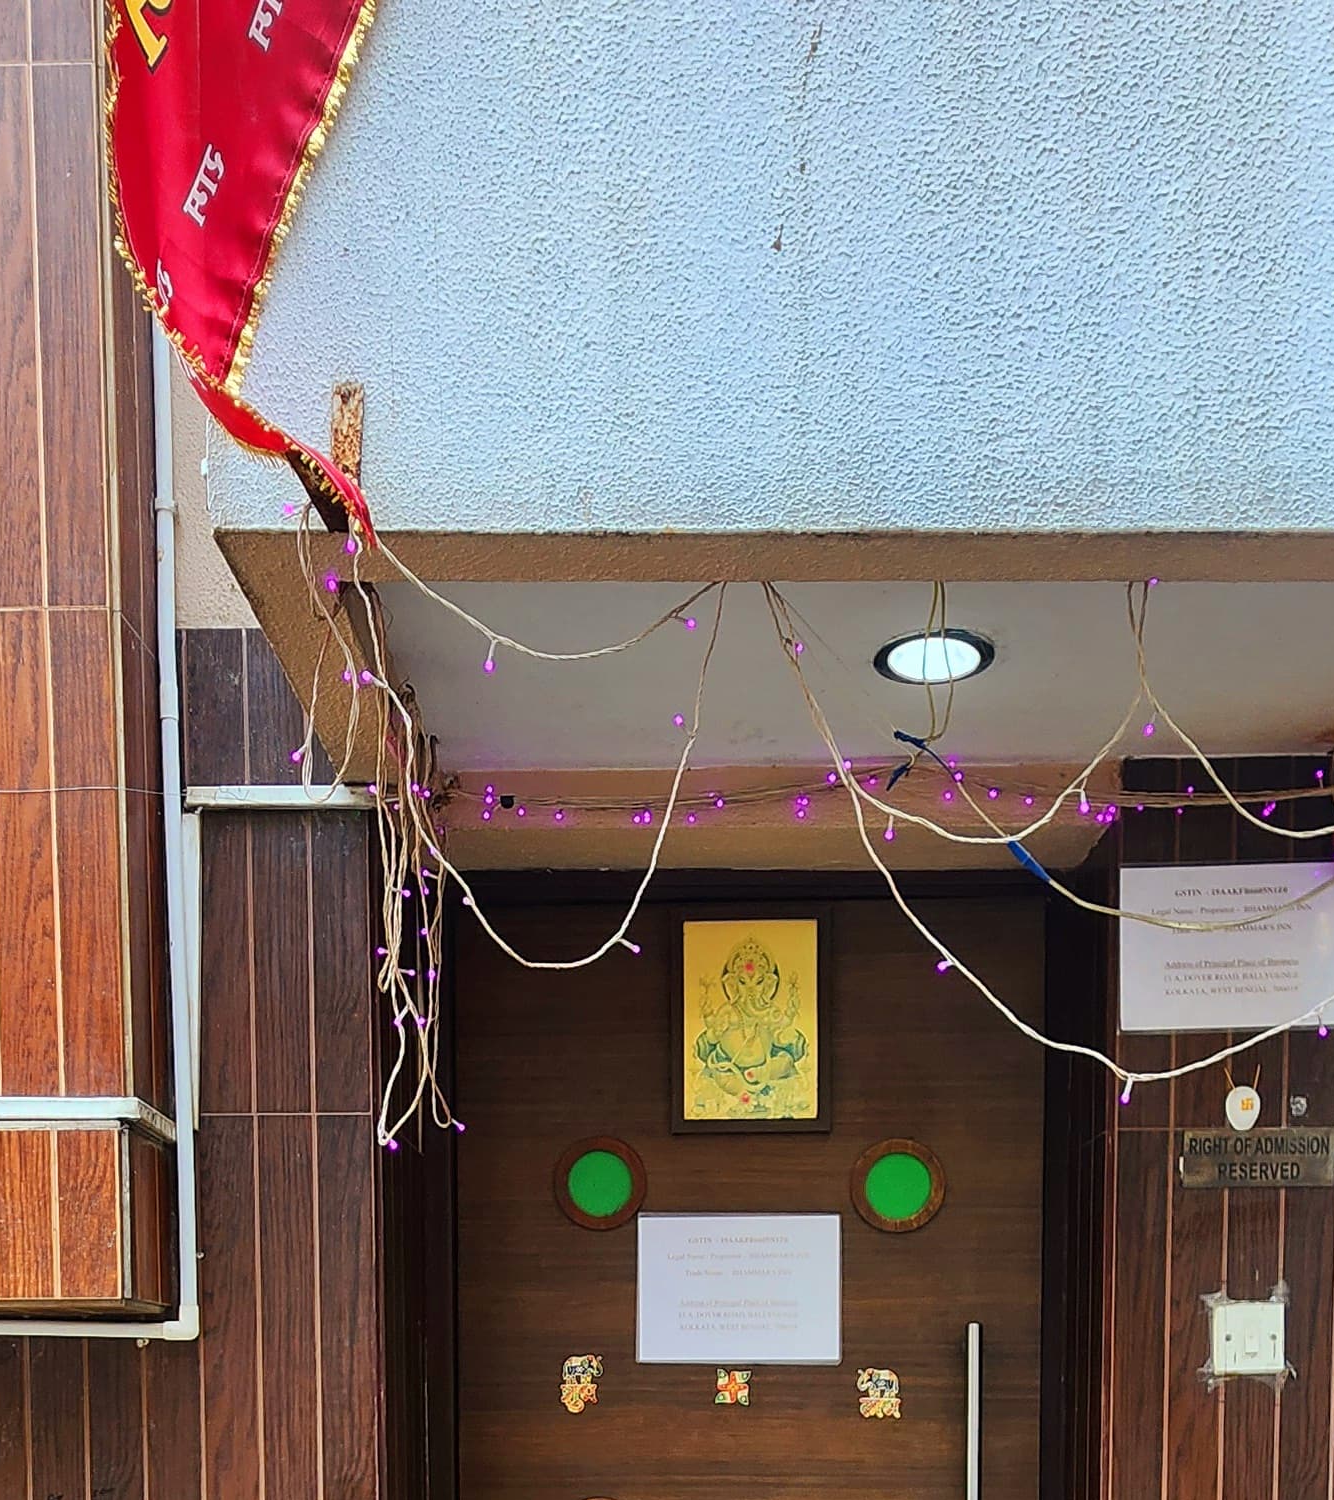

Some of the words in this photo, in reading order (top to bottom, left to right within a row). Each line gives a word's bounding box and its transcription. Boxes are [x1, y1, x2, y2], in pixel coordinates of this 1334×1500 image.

[1189, 1137, 1230, 1156] RIGHT
[1233, 1136, 1252, 1155] OF
[1255, 1135, 1331, 1155] ADMISSION
[1218, 1161, 1301, 1181] RESERVED
